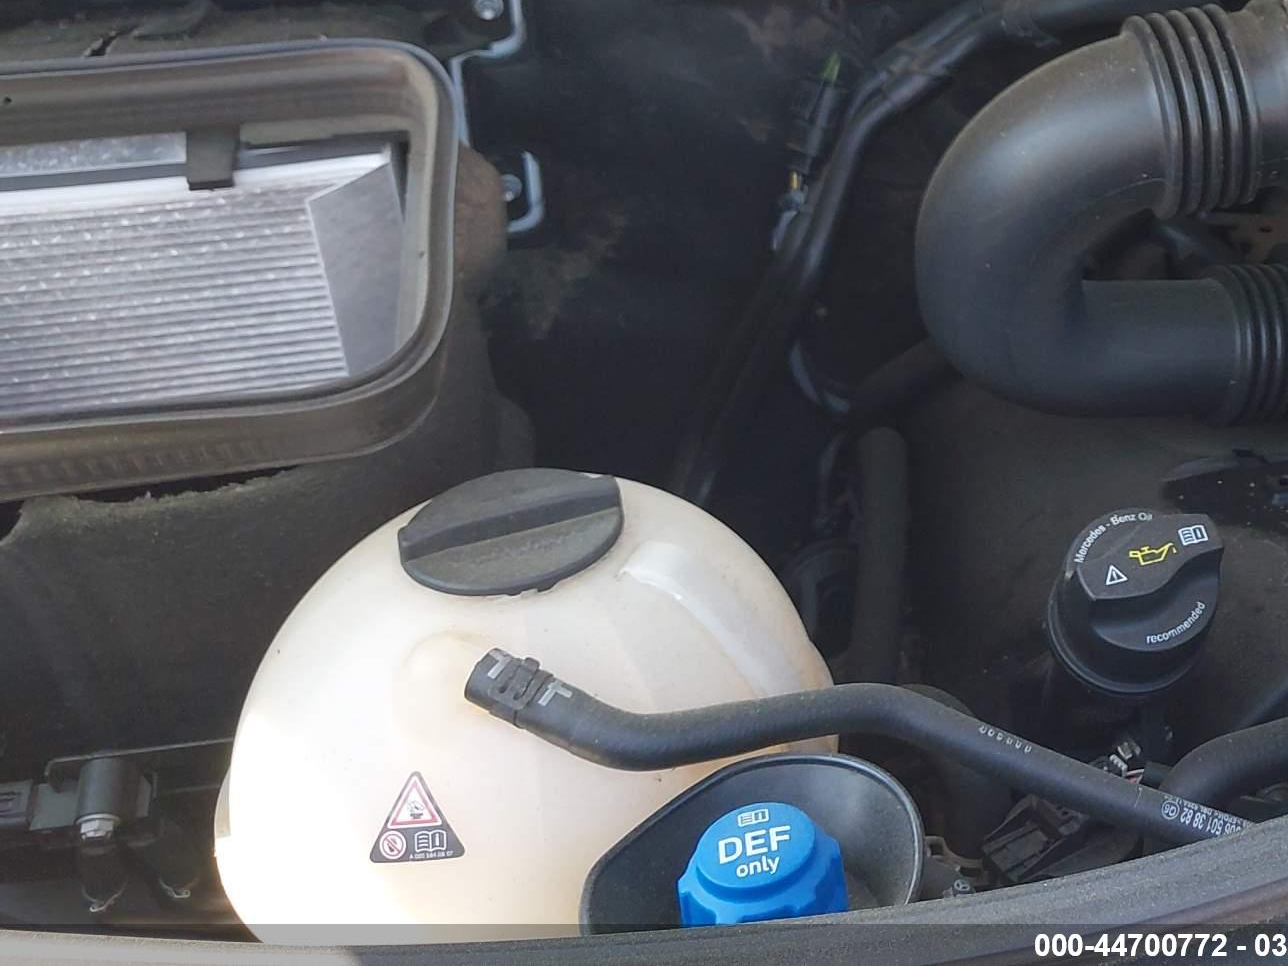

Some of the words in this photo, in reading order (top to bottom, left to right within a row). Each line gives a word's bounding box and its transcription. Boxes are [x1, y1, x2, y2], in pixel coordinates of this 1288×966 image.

[1074, 523, 1106, 564] Mercedes
[1110, 512, 1137, 526] Benz
[1146, 601, 1206, 644] recommended
[1180, 807, 1194, 826] 82
[1192, 811, 1207, 830] 38
[1206, 818, 1224, 835] 501
[718, 825, 791, 864] DEF
[736, 855, 780, 878] only
